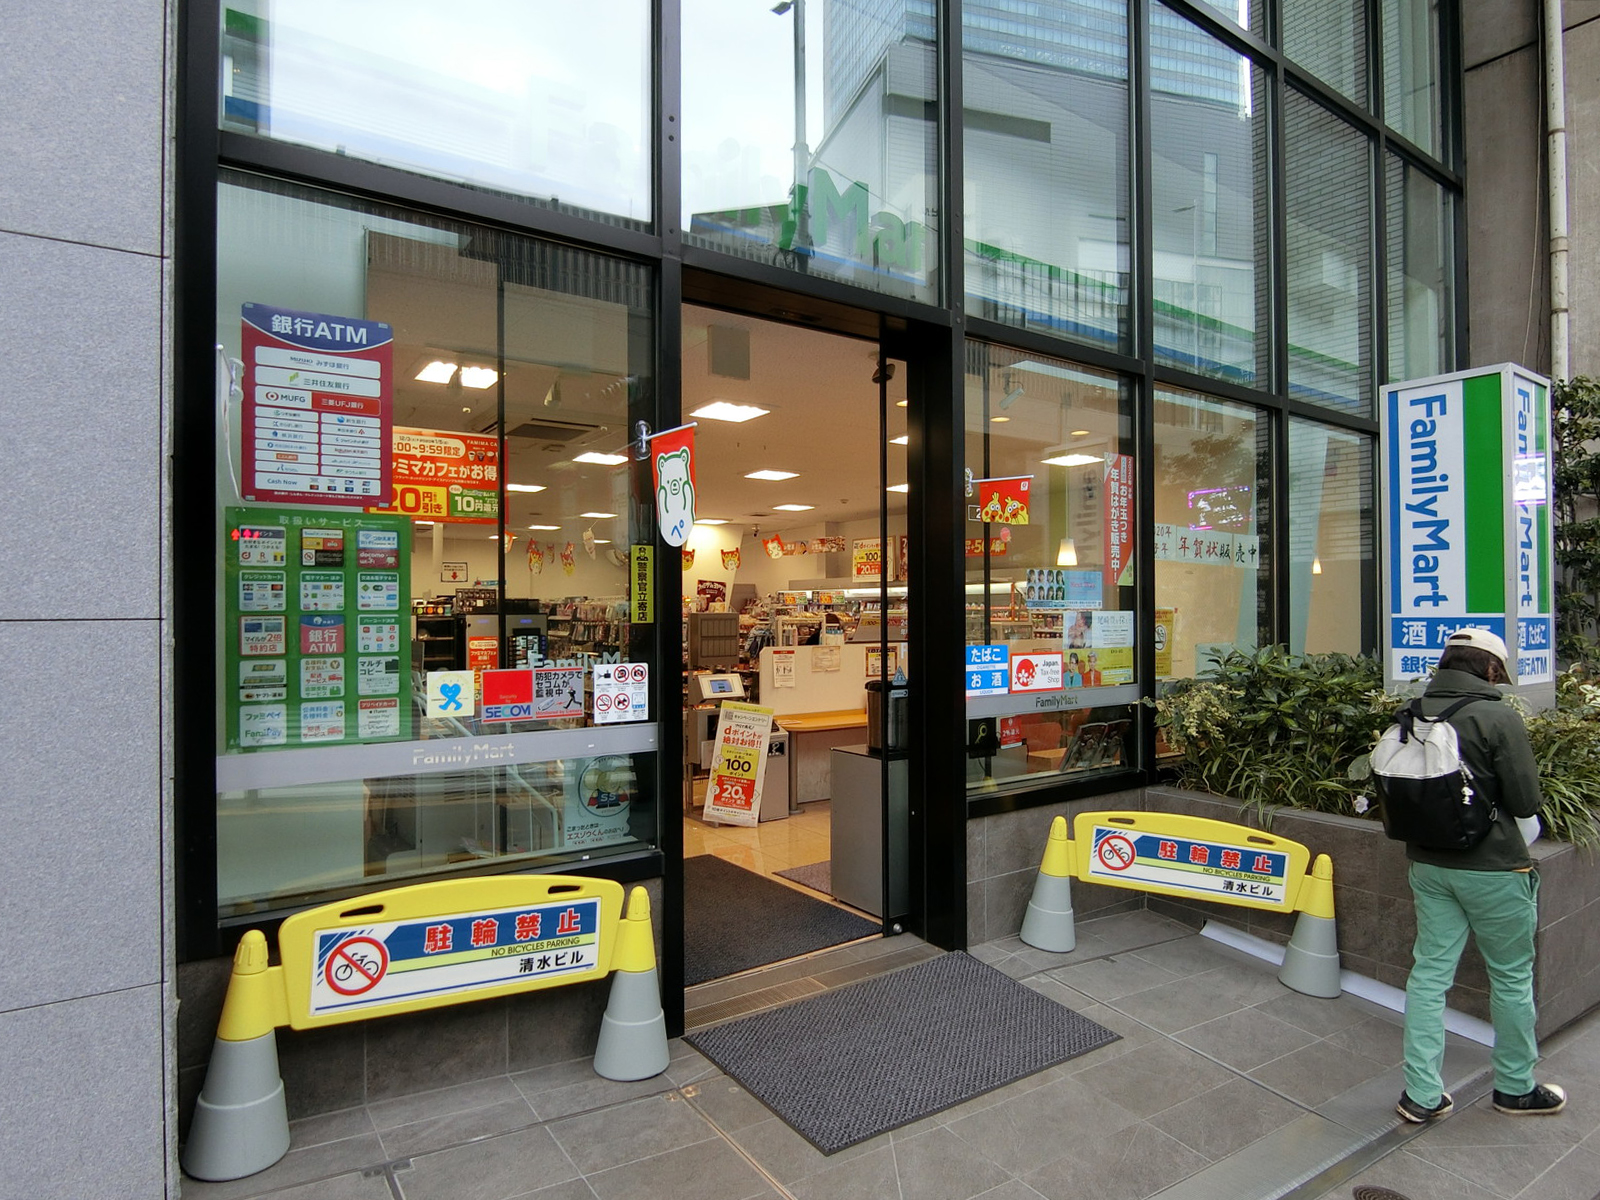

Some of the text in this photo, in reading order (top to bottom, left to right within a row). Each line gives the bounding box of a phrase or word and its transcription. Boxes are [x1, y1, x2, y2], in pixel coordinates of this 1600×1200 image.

[271, 314, 368, 345] 銀行ATM
[303, 378, 350, 390] 三井住友銀行
[280, 394, 306, 403] MUFG
[1404, 393, 1451, 608] FamilyMart
[278, 515, 363, 528] 取扱いサービス
[636, 560, 648, 622] 警察官立寄店
[308, 629, 338, 643] 銀行
[1401, 620, 1428, 647] 酒
[1517, 621, 1527, 648] 酒
[1528, 623, 1547, 645] たばこ
[308, 642, 338, 654] ATM
[971, 647, 1002, 662] たばこ
[359, 659, 383, 668] マルチ
[1517, 656, 1548, 676] 銀行ATM
[359, 668, 383, 676] コピー
[535, 670, 583, 681] 防犯カメラで
[1040, 668, 1060, 676] Tax-free
[535, 680, 570, 689] セコムが
[1047, 676, 1060, 684] Shop
[535, 688, 564, 698] 監視中
[1035, 694, 1079, 709] FamilyMart
[244, 711, 282, 721] ファミペイ
[485, 704, 531, 719] SECOM
[412, 742, 515, 766] FamilyMart
[725, 758, 752, 773] 100
[1158, 840, 1273, 874] 駐輪禁止
[1202, 866, 1271, 883] NO BICYCLES PARKING
[1221, 879, 1274, 897] 清水ビル
[423, 907, 582, 956] 駐輪禁止
[490, 935, 581, 958] NO BICYCLES PARKING
[518, 950, 585, 975] 清水ビル
